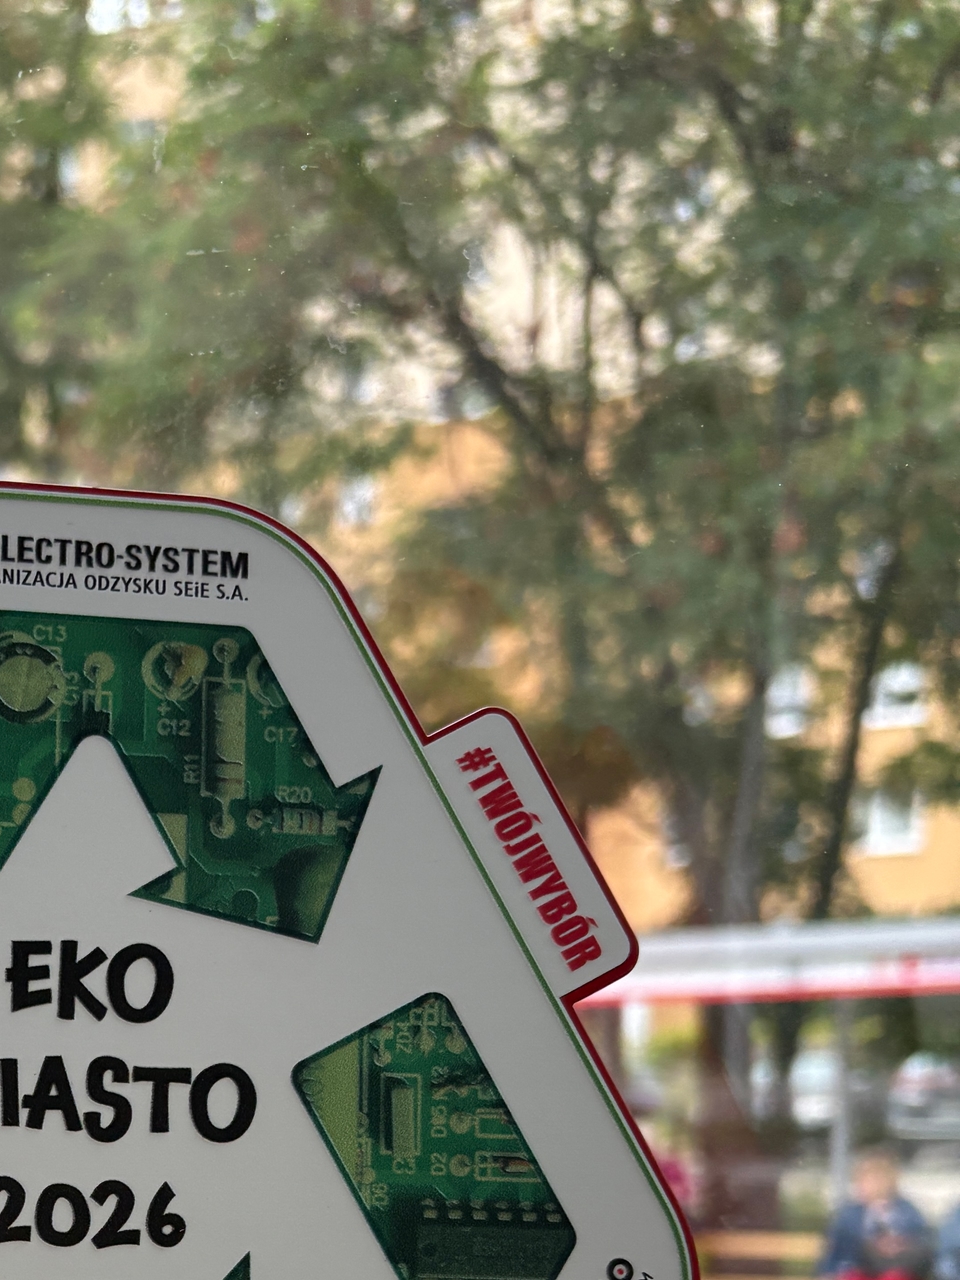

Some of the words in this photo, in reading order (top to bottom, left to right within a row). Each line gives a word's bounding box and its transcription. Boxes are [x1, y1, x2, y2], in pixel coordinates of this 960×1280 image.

[84, 575, 166, 595] ODZYSKU
[173, 580, 210, 599] SEiE
[216, 584, 249, 601] S.A.
[455, 747, 602, 972] #TWÓJWYBÓR
[5, 940, 174, 1024] EKO
